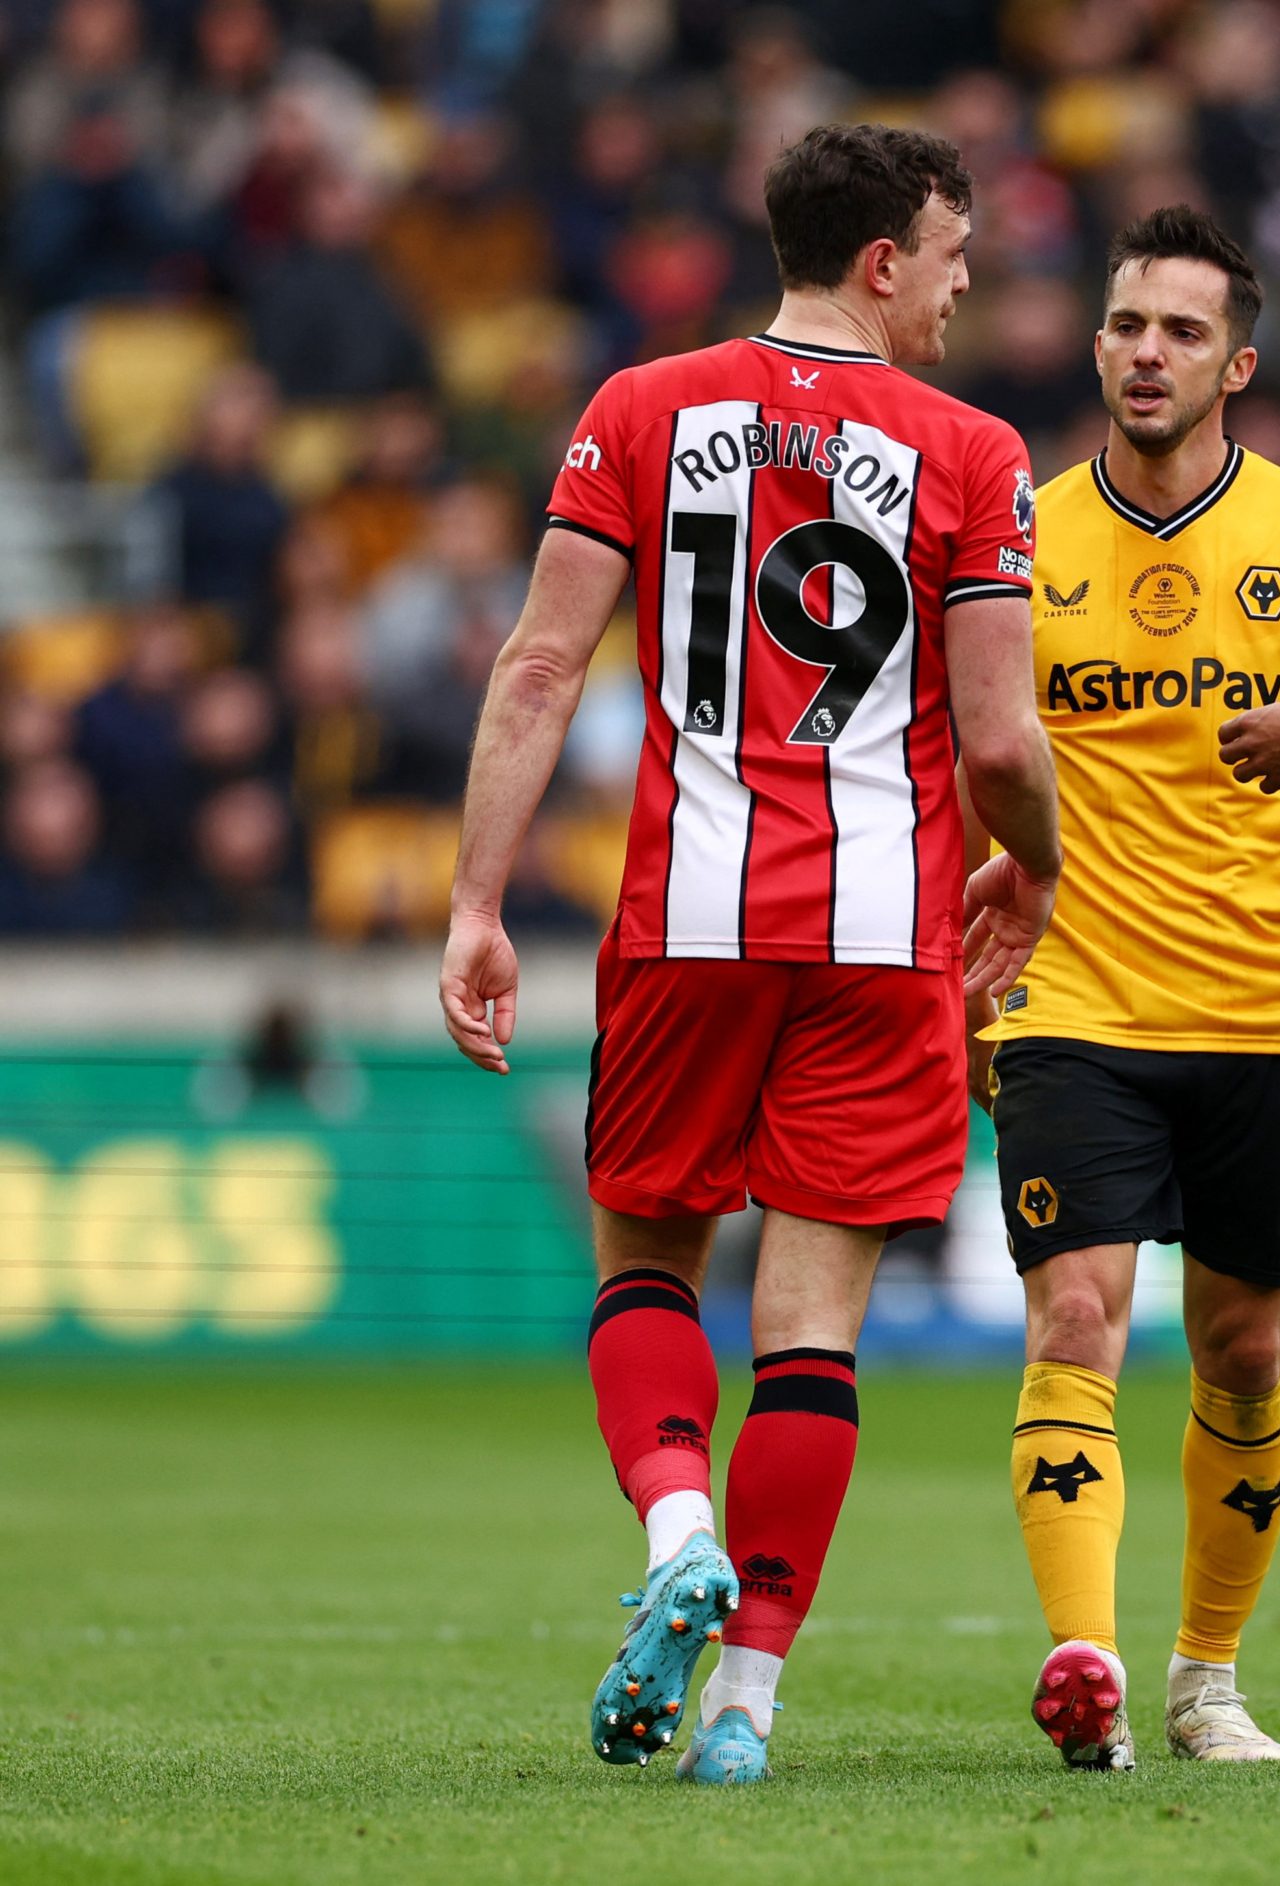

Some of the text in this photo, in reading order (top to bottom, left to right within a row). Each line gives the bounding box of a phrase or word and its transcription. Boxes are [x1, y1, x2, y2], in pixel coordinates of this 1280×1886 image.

[673, 421, 910, 518] ROBINSON
[1129, 563, 1201, 599] FOUNDATION FOCUS FIXTURE
[669, 510, 911, 745] 19
[1043, 608, 1088, 618] CASTORE
[1129, 607, 1198, 637] 25TH FEBRUARY 2024
